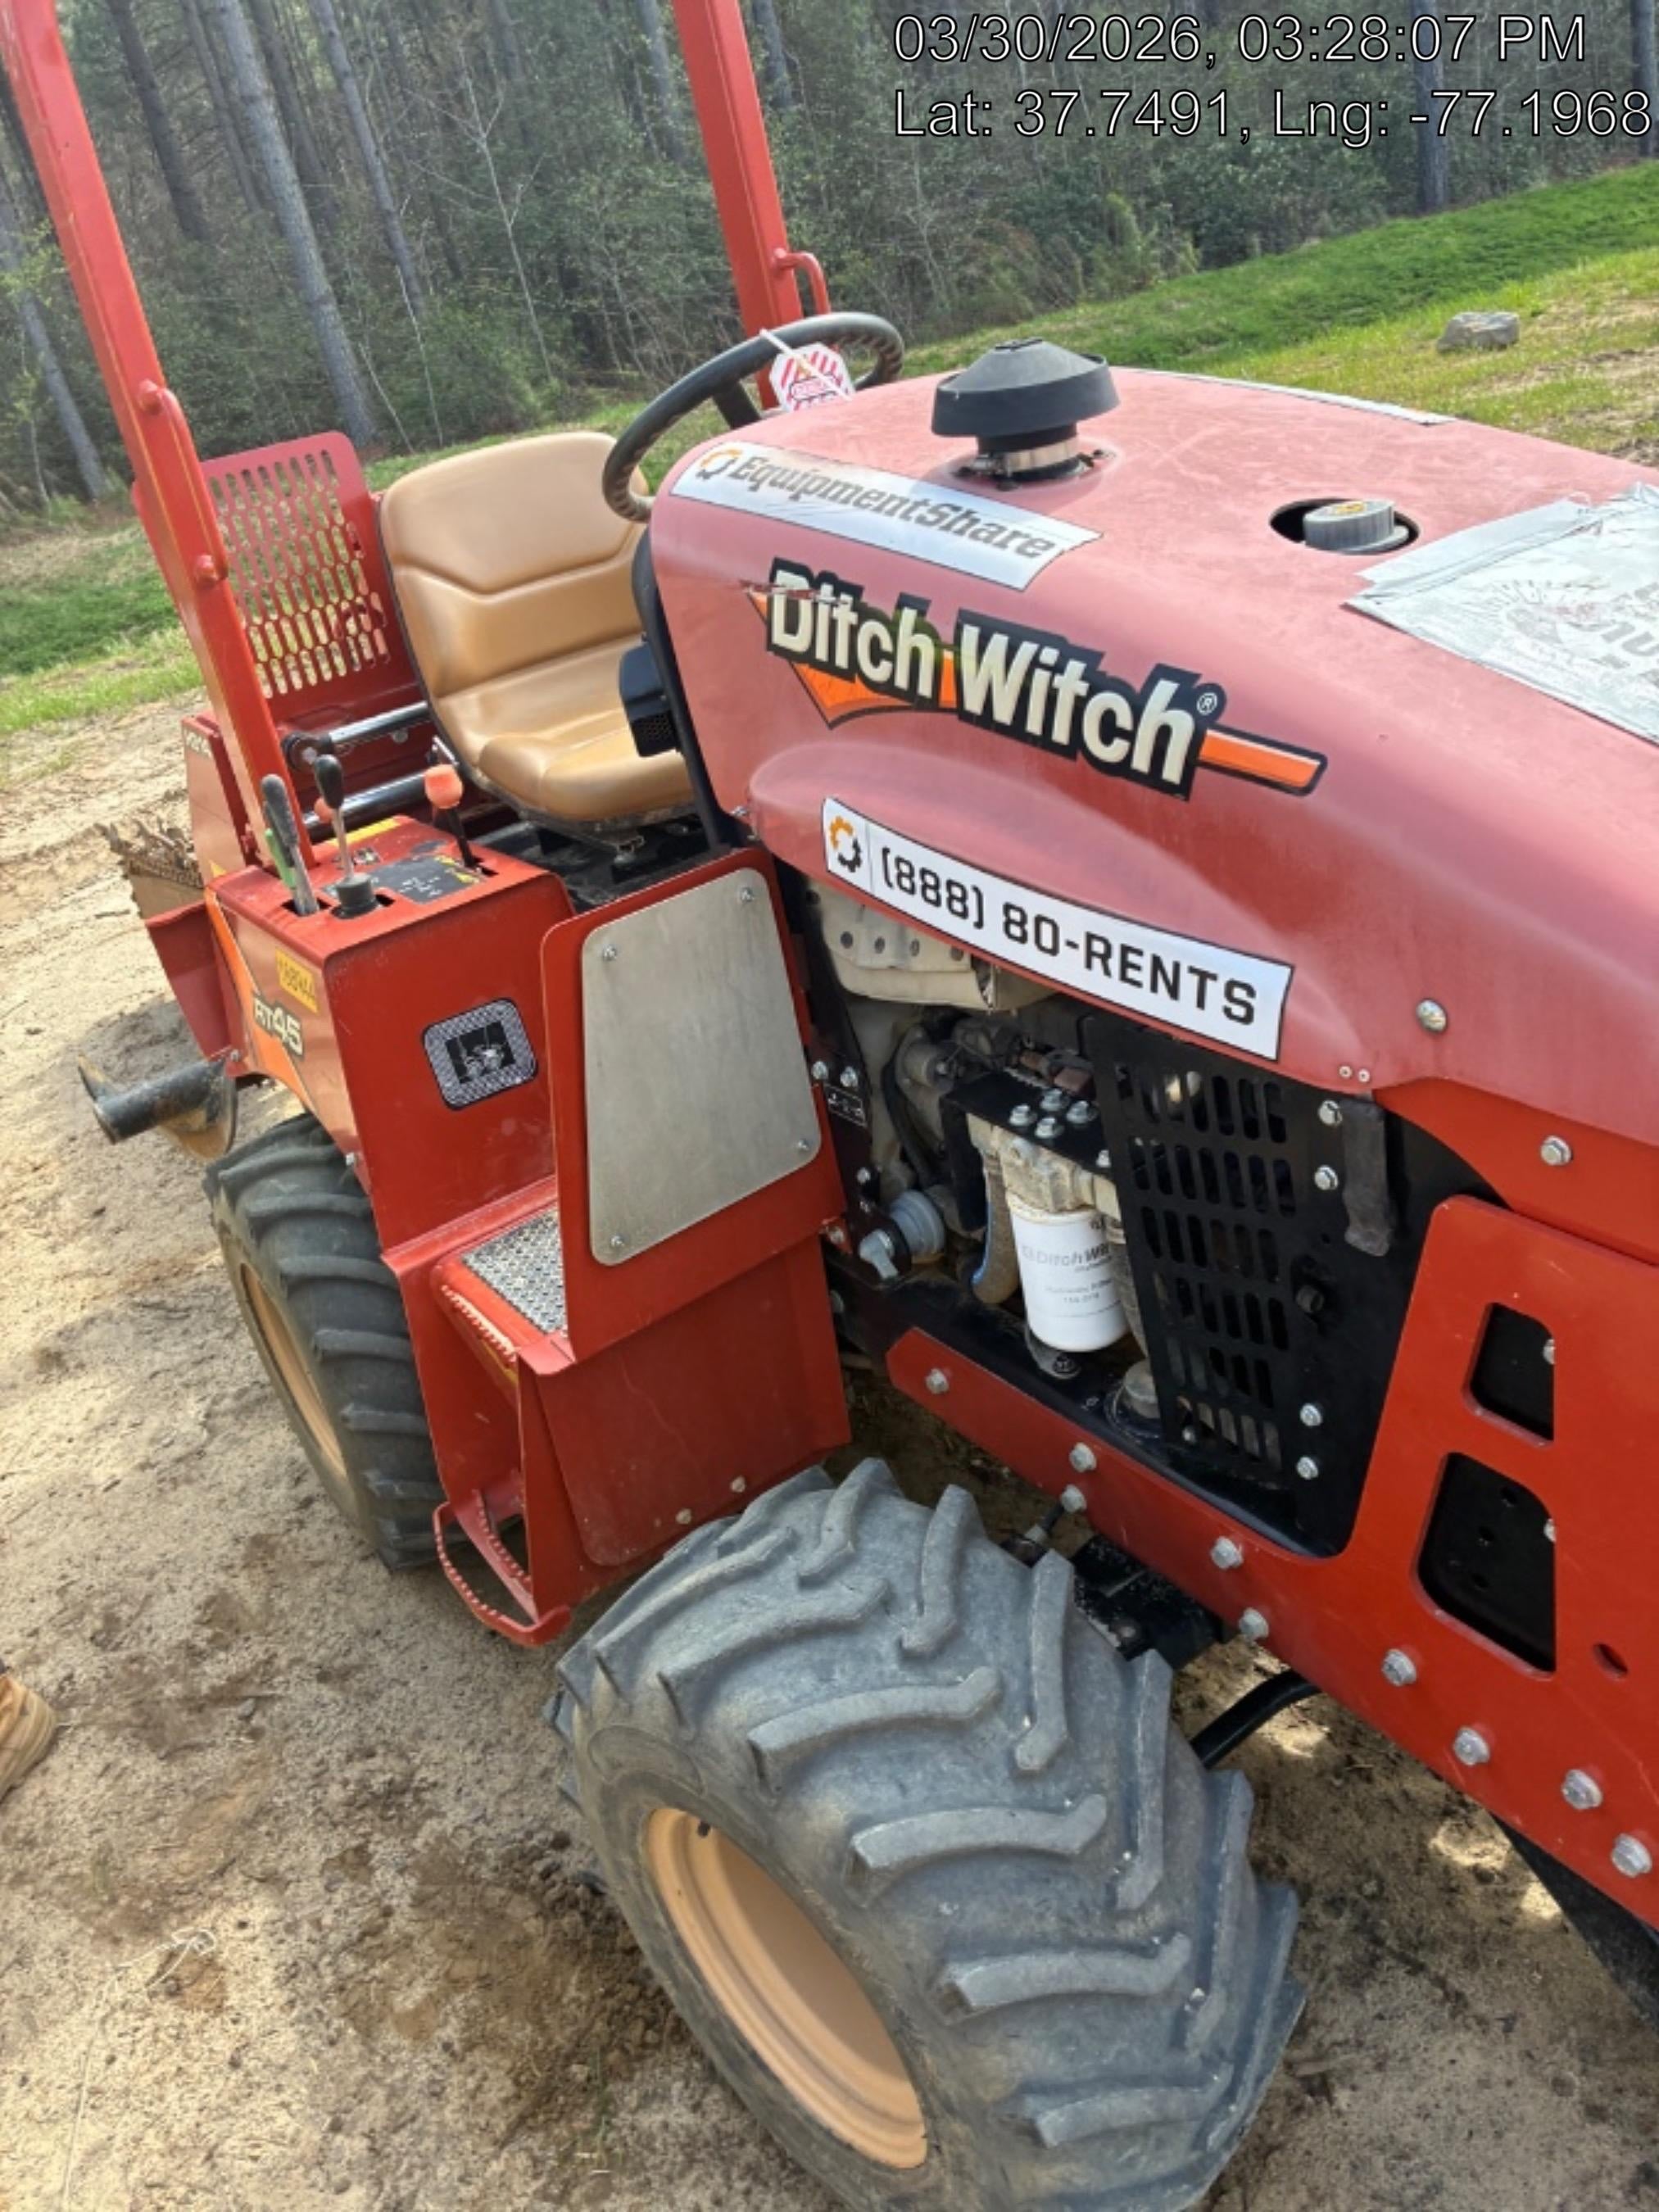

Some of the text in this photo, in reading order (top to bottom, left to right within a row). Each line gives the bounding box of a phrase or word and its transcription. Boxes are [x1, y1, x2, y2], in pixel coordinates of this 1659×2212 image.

[728, 455, 1057, 559] EquipmentShare
[768, 564, 937, 703] Ditch
[881, 846, 1258, 1026] (888) 80-RENTS
[253, 995, 305, 1057] RT45
